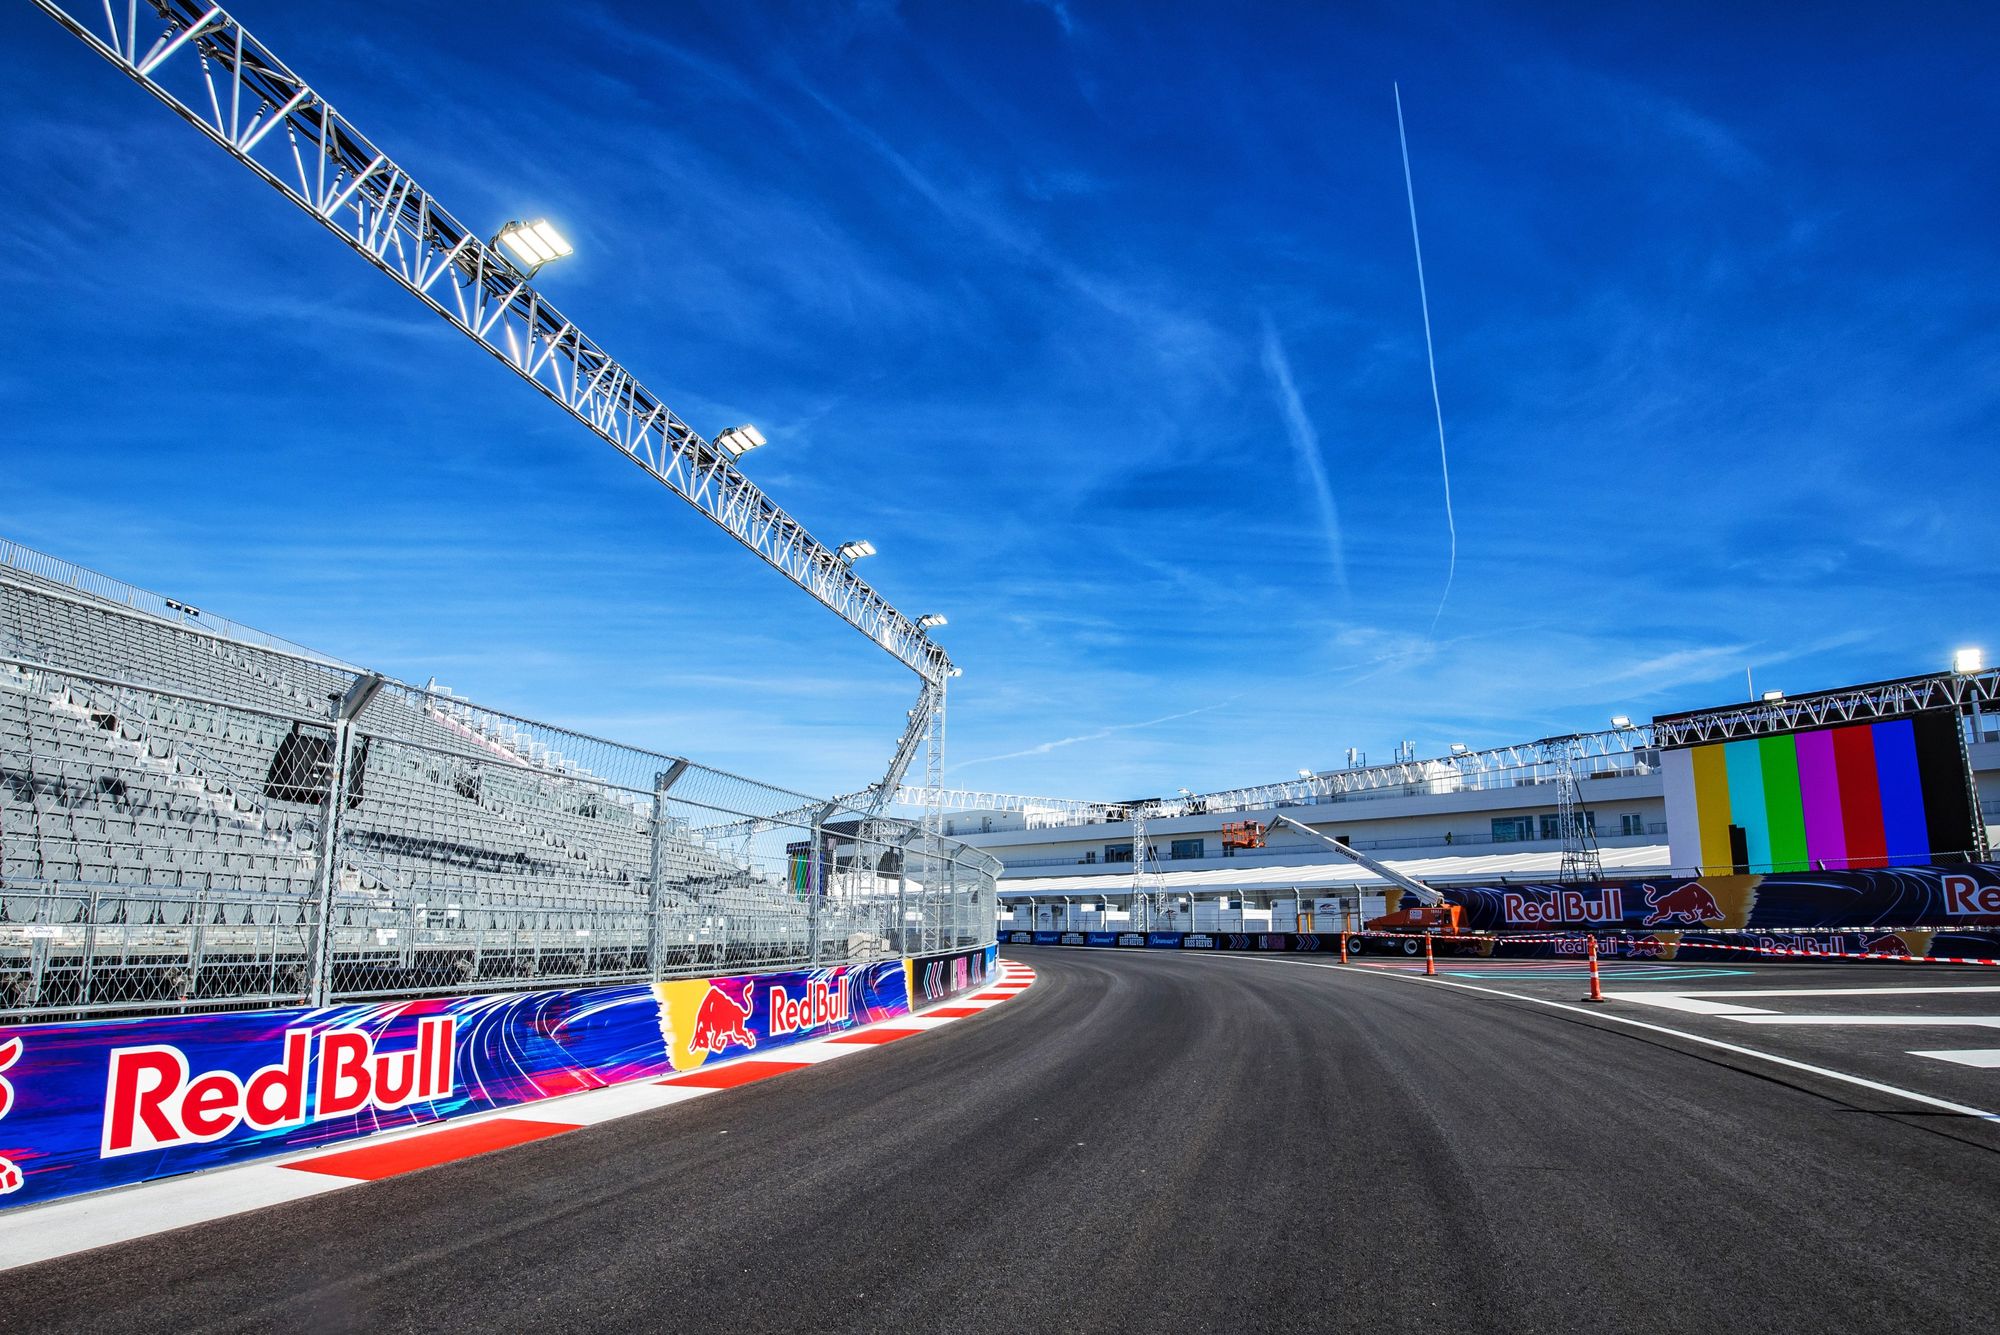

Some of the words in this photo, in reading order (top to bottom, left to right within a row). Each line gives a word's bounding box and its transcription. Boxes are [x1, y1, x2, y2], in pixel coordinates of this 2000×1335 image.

[1504, 890, 1563, 923] Red
[1563, 888, 1624, 922] Bull
[1760, 936, 1801, 956] Red
[1802, 936, 1845, 956] Bull
[770, 980, 814, 1037] Red
[814, 976, 849, 1027] Bull
[100, 1027, 312, 1159] Red
[313, 1015, 457, 1123] Bull
